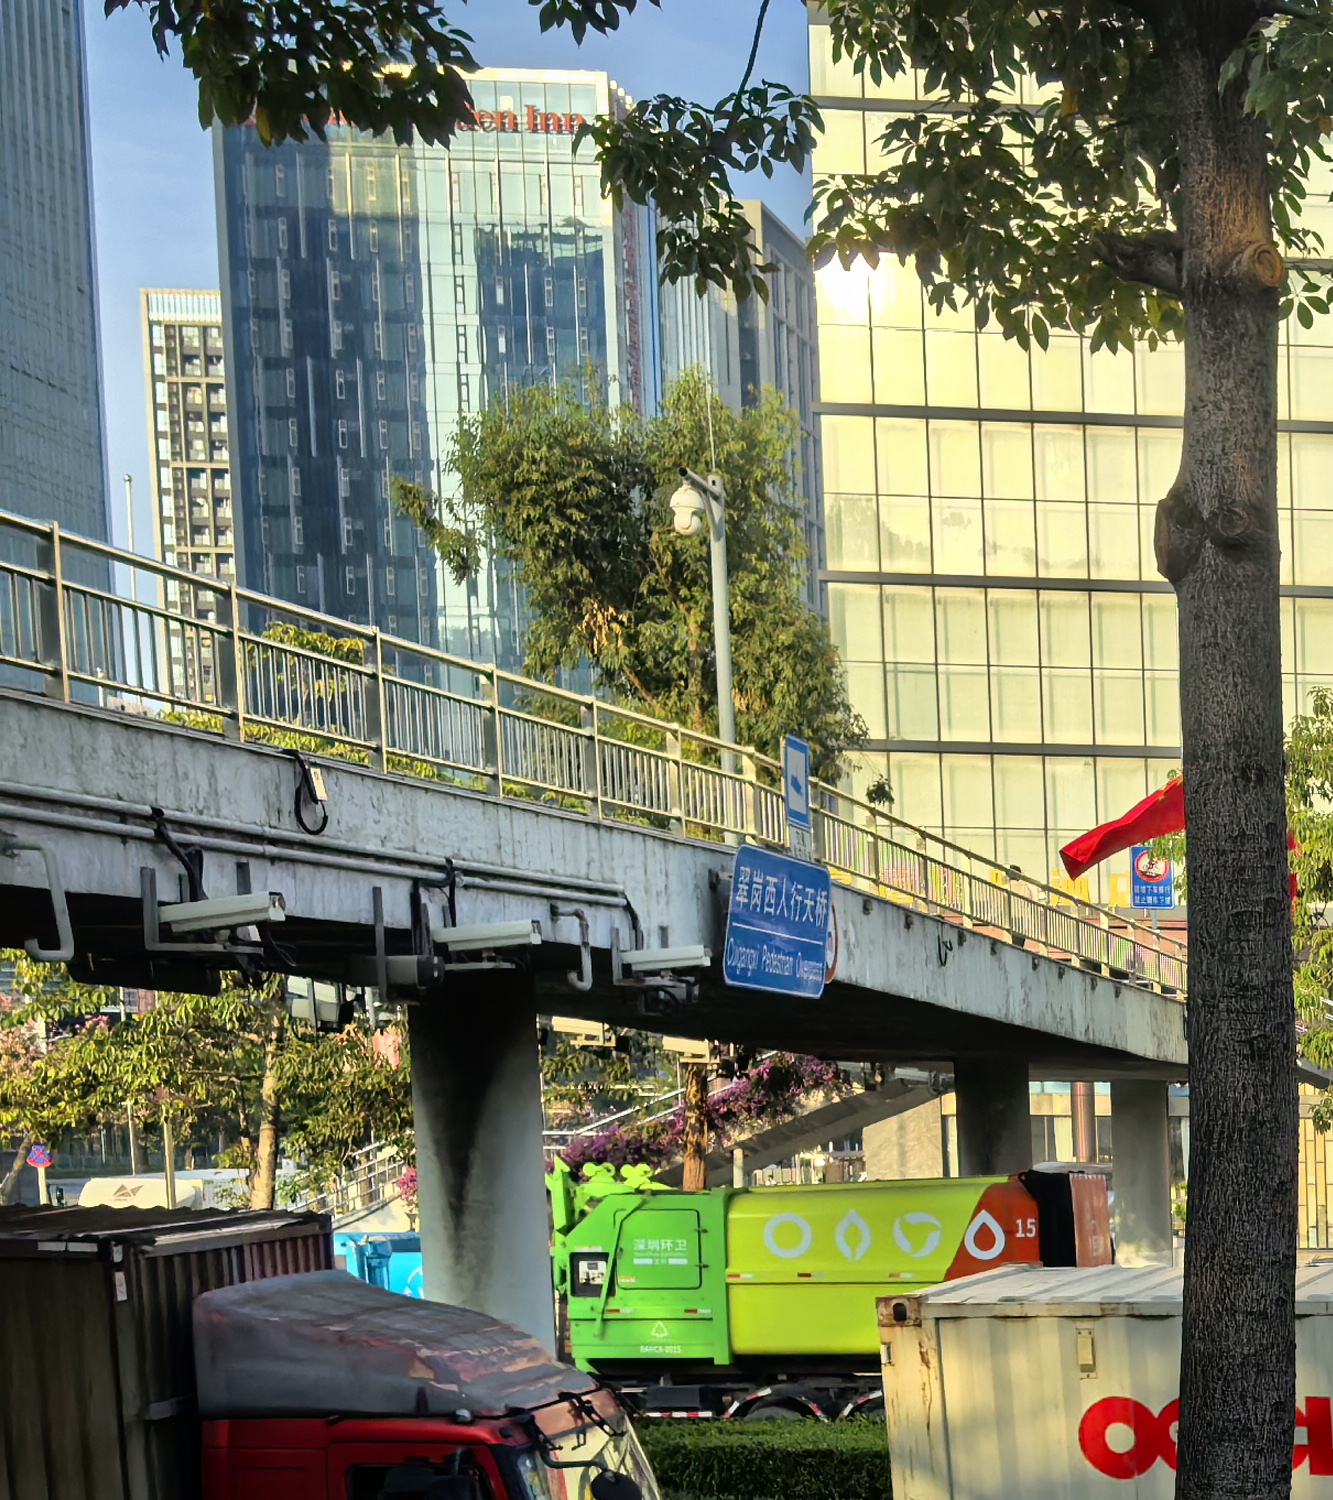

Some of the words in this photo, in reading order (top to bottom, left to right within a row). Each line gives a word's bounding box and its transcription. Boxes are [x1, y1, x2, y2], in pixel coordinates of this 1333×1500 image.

[736, 866, 828, 929] 翠岗西人行天桥
[1015, 1218, 1037, 1238] 15
